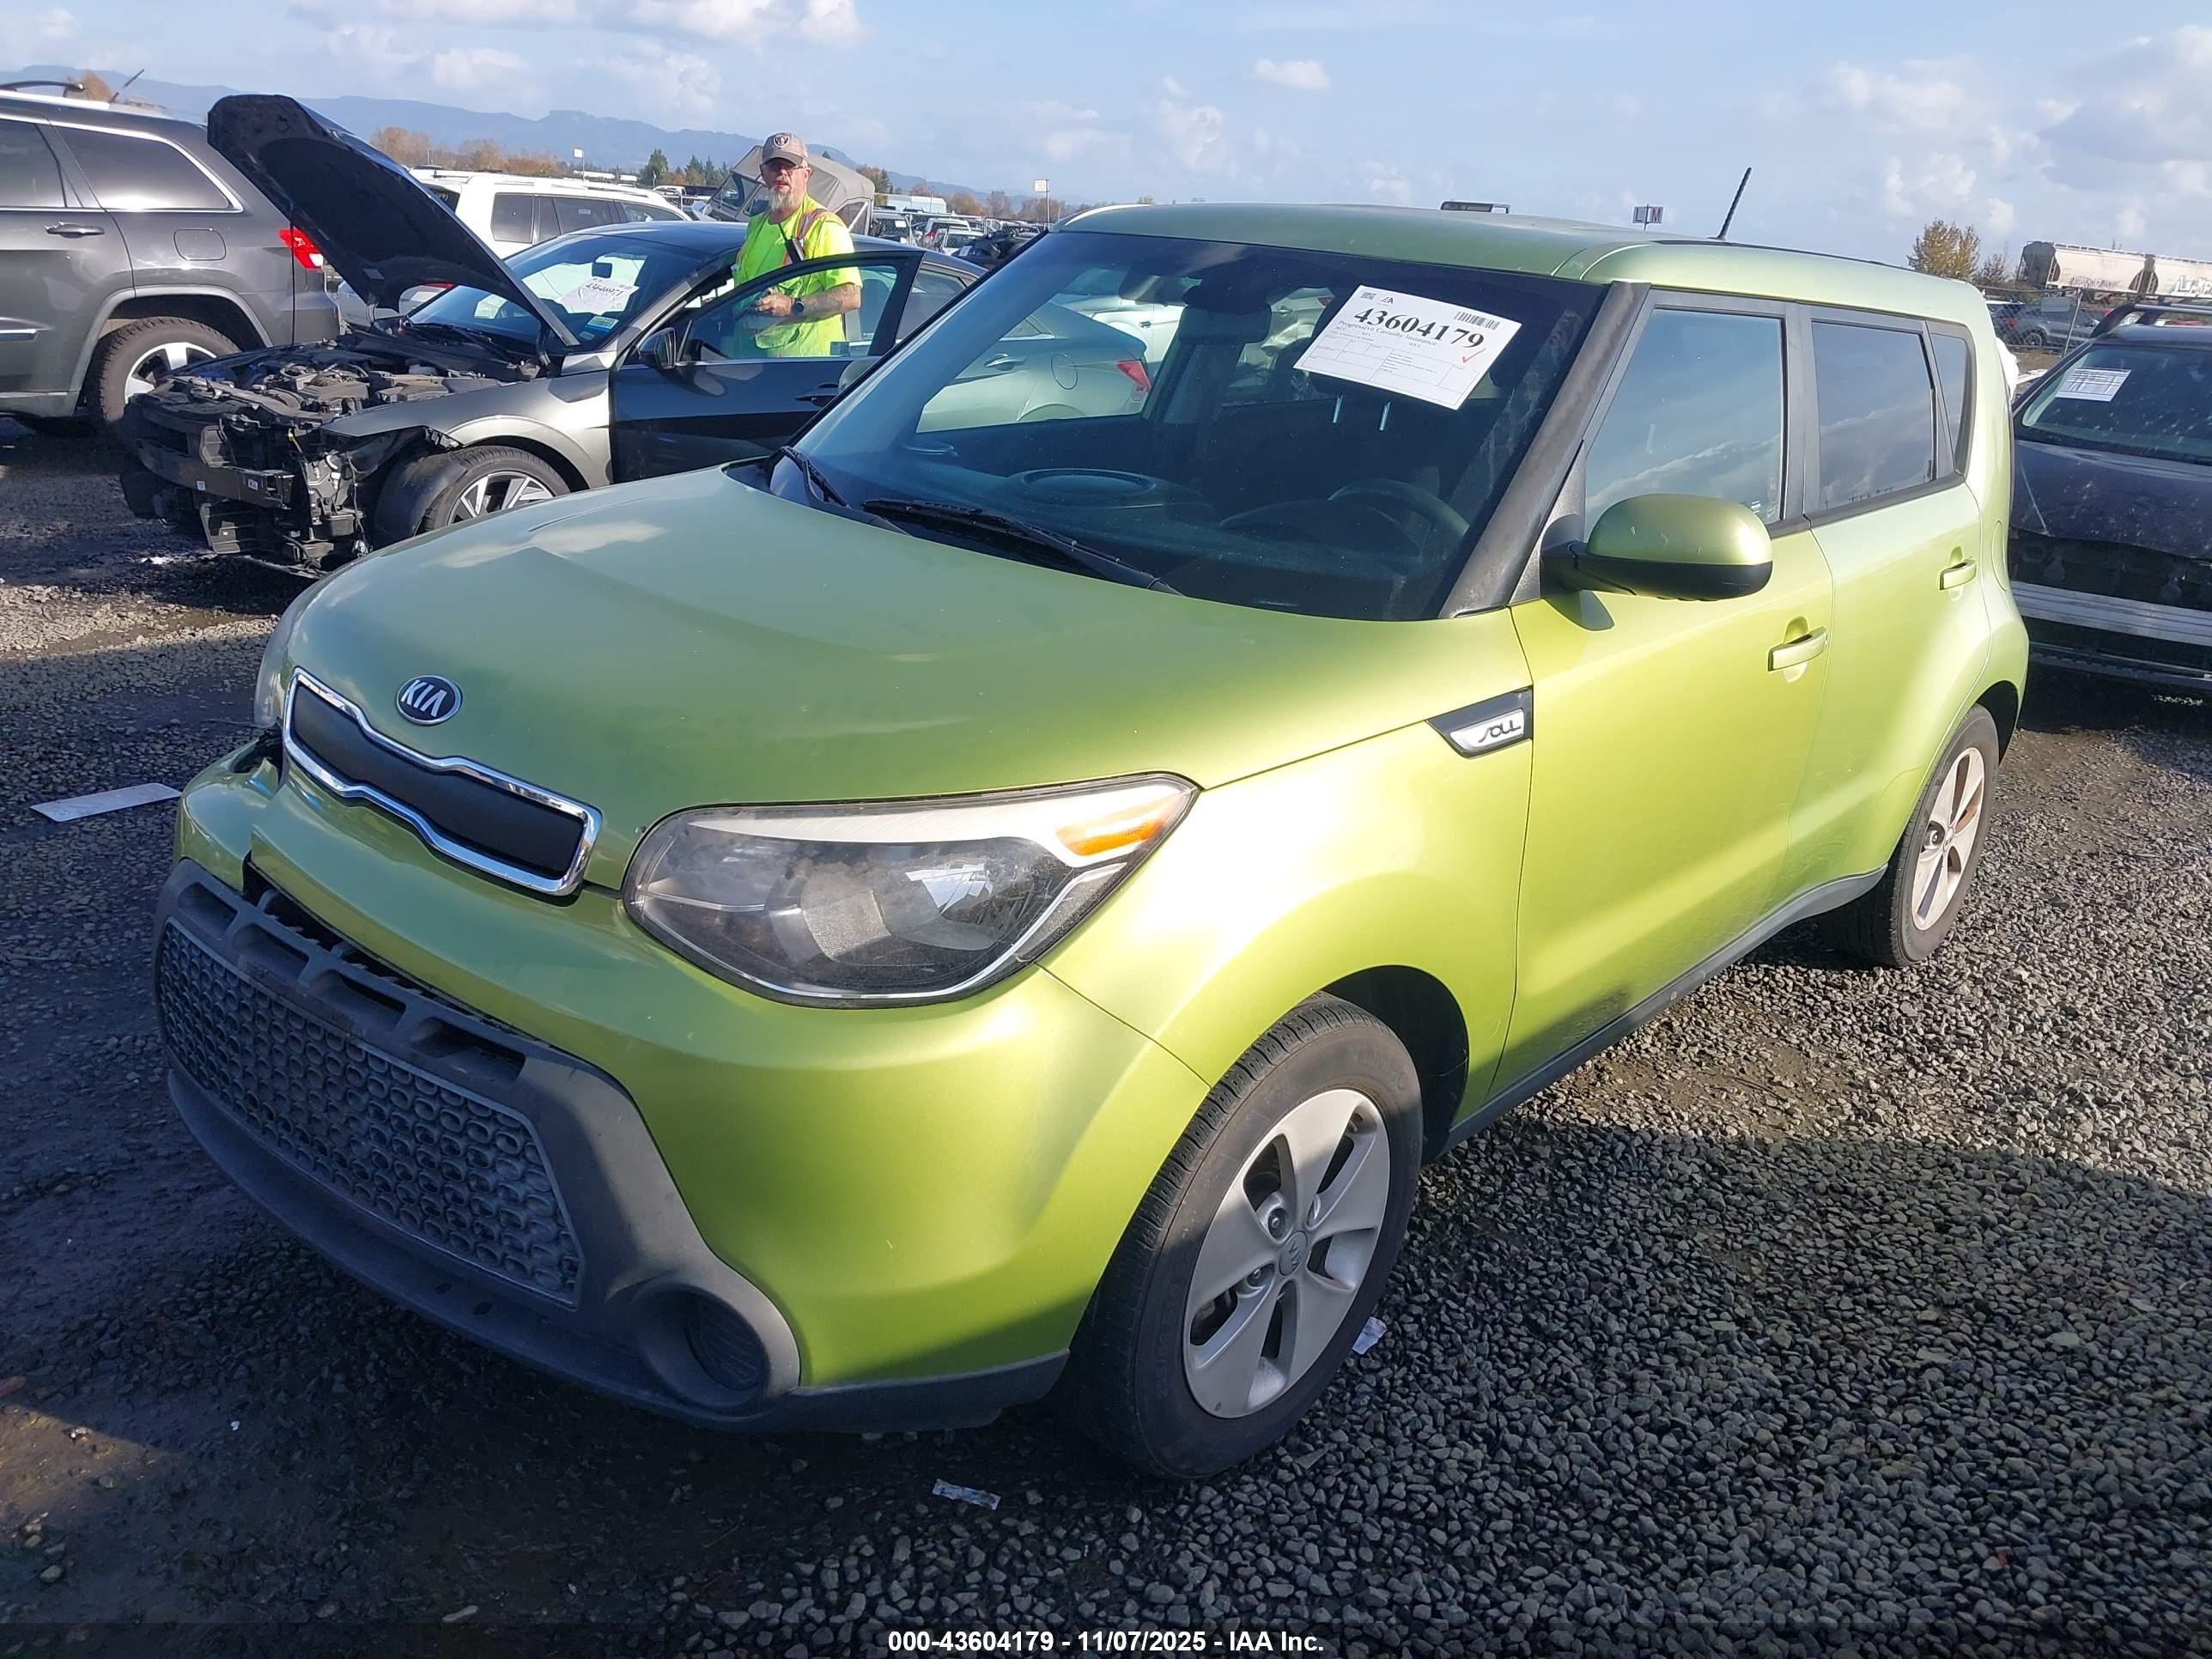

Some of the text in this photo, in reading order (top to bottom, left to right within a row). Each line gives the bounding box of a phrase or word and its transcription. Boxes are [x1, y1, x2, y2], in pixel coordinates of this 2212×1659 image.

[1634, 206, 1643, 222] L
[1650, 206, 1662, 222] M
[1338, 319, 1375, 332] Progressive
[1405, 334, 1437, 347] Insurance
[1353, 307, 1485, 349] 43604179
[400, 679, 447, 718] KIA
